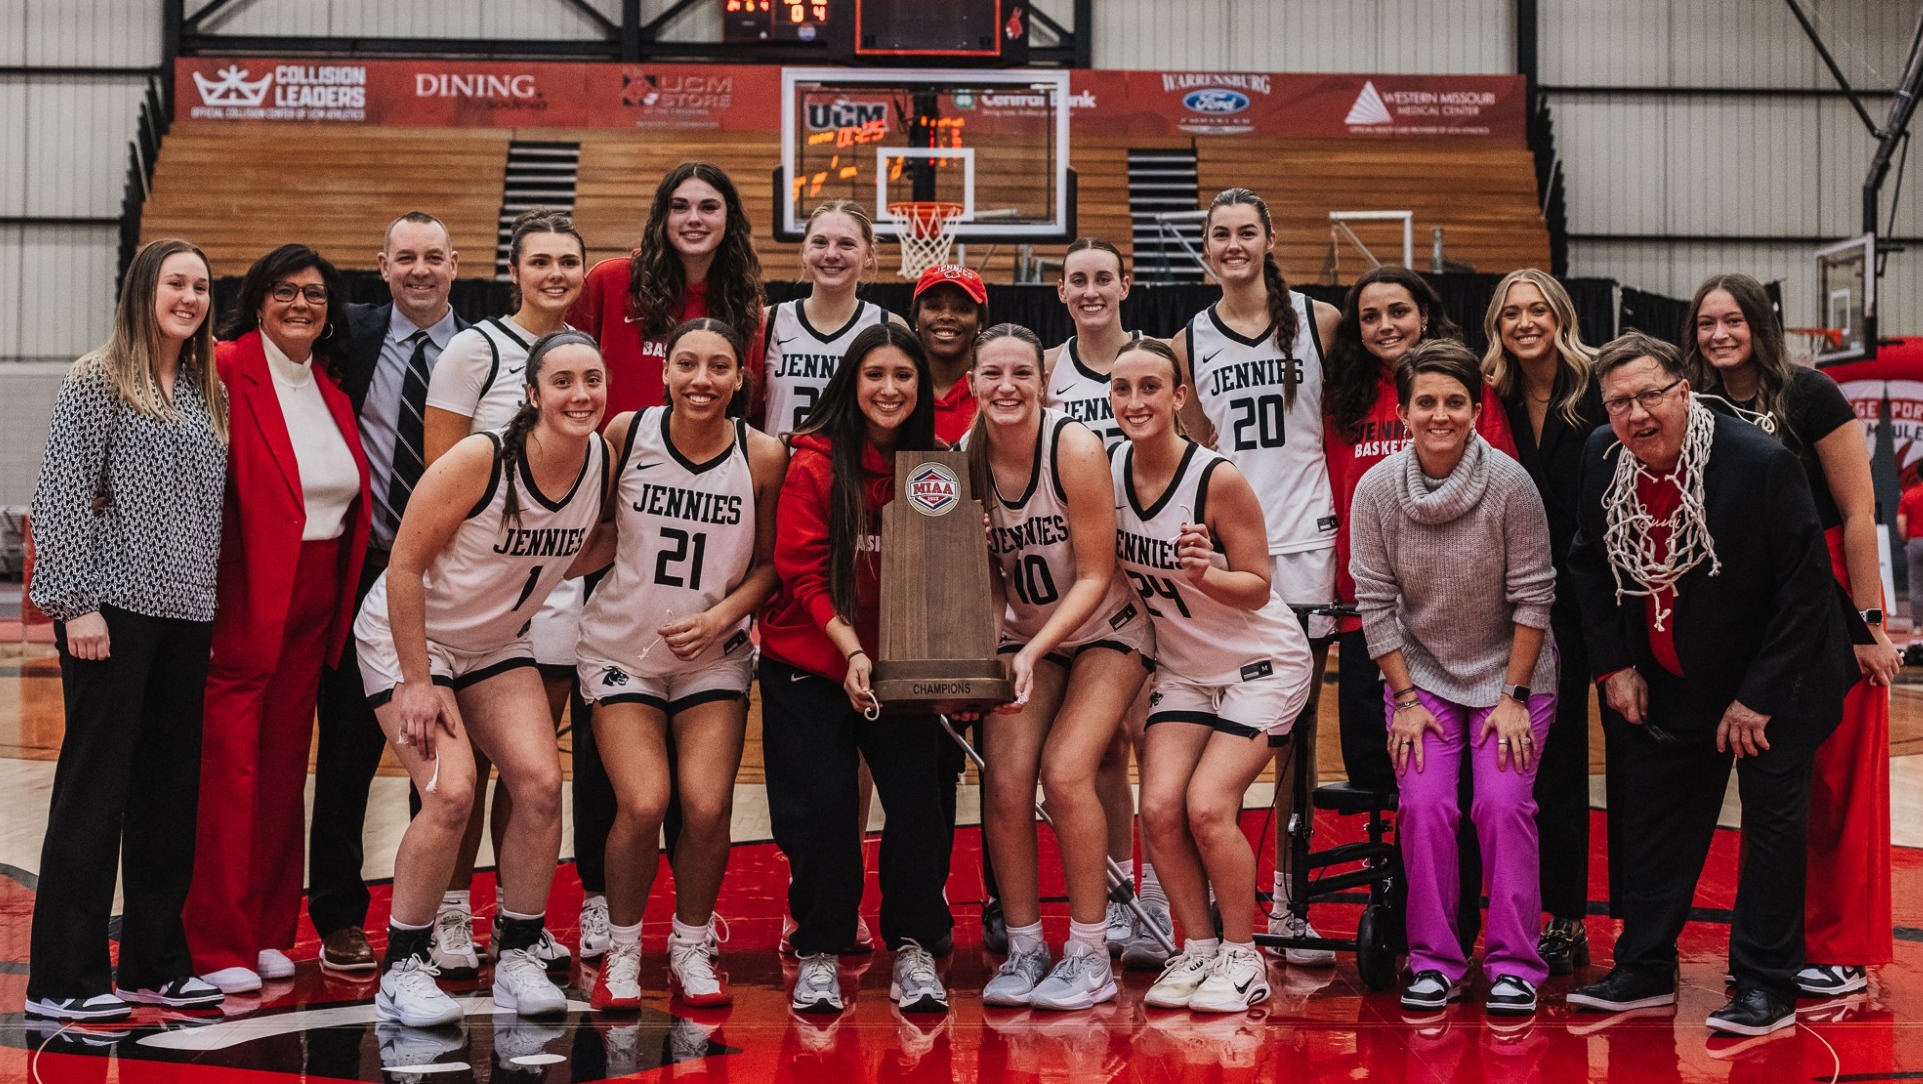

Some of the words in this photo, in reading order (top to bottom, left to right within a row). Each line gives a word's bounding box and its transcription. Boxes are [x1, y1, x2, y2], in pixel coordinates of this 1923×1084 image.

[275, 65, 366, 85] COLLISION
[415, 73, 535, 98] DINING
[661, 76, 732, 92] UCM
[1162, 74, 1271, 95] WARRENSBURG
[275, 86, 366, 107] LEADERS
[661, 94, 731, 108] STORE
[1382, 92, 1438, 103] WESTERN
[1439, 92, 1496, 104] MISSOURI
[808, 103, 885, 129] UCM
[1397, 105, 1439, 115] MEDICAL
[1442, 106, 1479, 115] CENTER
[933, 264, 974, 280] JENNIES
[774, 354, 844, 378] JENN
[1210, 358, 1304, 396] JENNIES
[1230, 394, 1286, 452] 20
[913, 483, 954, 495] MIAA
[633, 484, 742, 525] JENNIES
[493, 528, 586, 557] JENNIES
[989, 514, 1069, 554] JENNIES
[654, 527, 707, 591] 21
[511, 565, 544, 612] 1
[1014, 554, 1059, 606] 10
[1123, 568, 1192, 619] 24
[913, 683, 971, 695] CHAMPIONS
